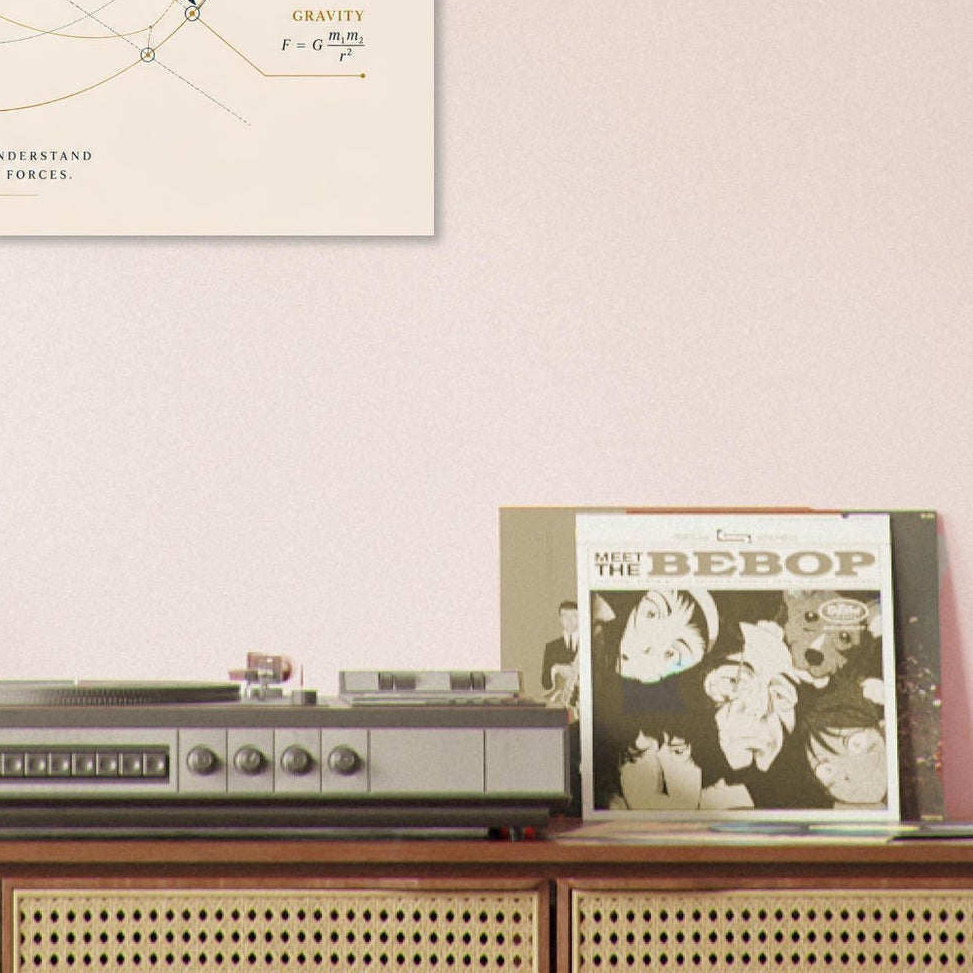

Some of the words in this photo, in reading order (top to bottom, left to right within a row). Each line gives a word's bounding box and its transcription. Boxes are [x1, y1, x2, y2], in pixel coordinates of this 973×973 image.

[292, 9, 364, 22] GRAVITY
[6, 169, 73, 180] FORCES.
[594, 551, 643, 563] MEET
[594, 563, 641, 577] THE
[646, 550, 876, 578] BEBOP
